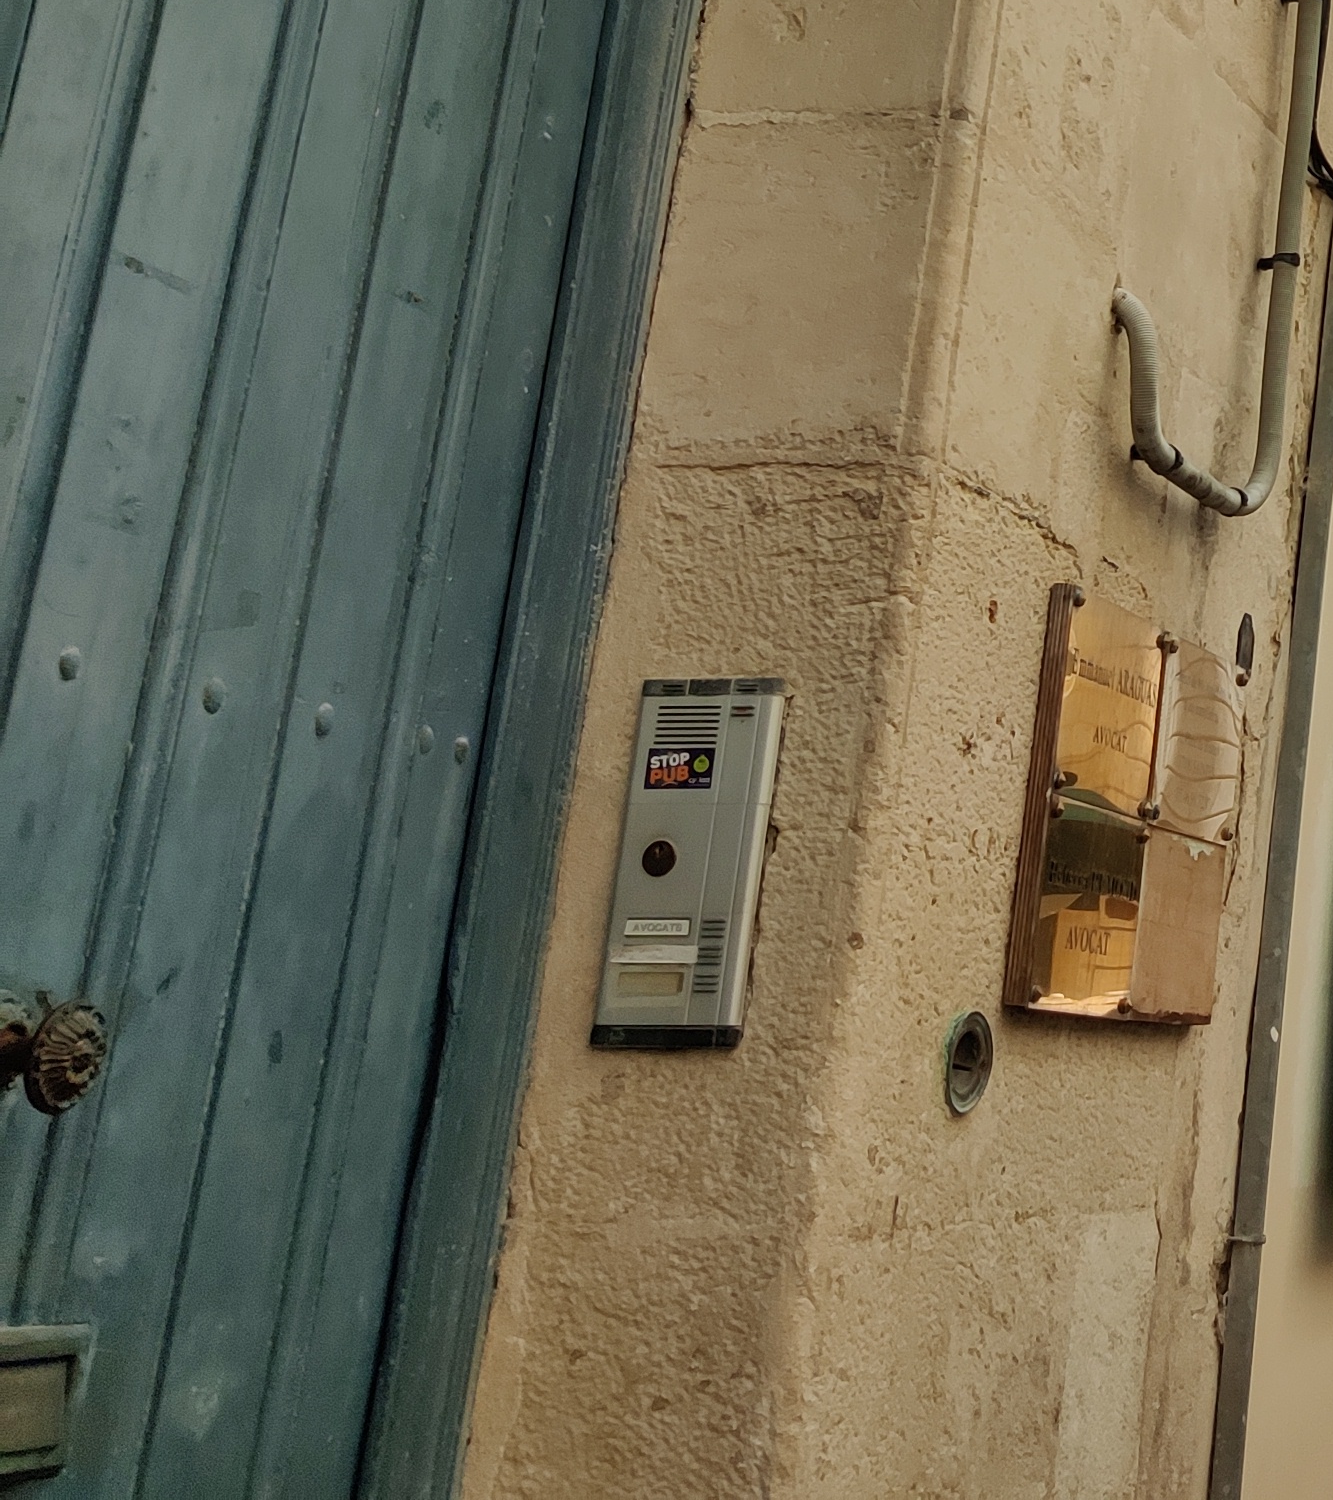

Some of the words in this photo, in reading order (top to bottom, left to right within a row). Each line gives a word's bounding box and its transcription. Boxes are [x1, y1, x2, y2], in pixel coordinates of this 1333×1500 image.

[1092, 725, 1127, 754] AVOCAT
[649, 752, 690, 769] STOP
[649, 765, 690, 785] PUB
[1065, 926, 1111, 956] AVOCAT
